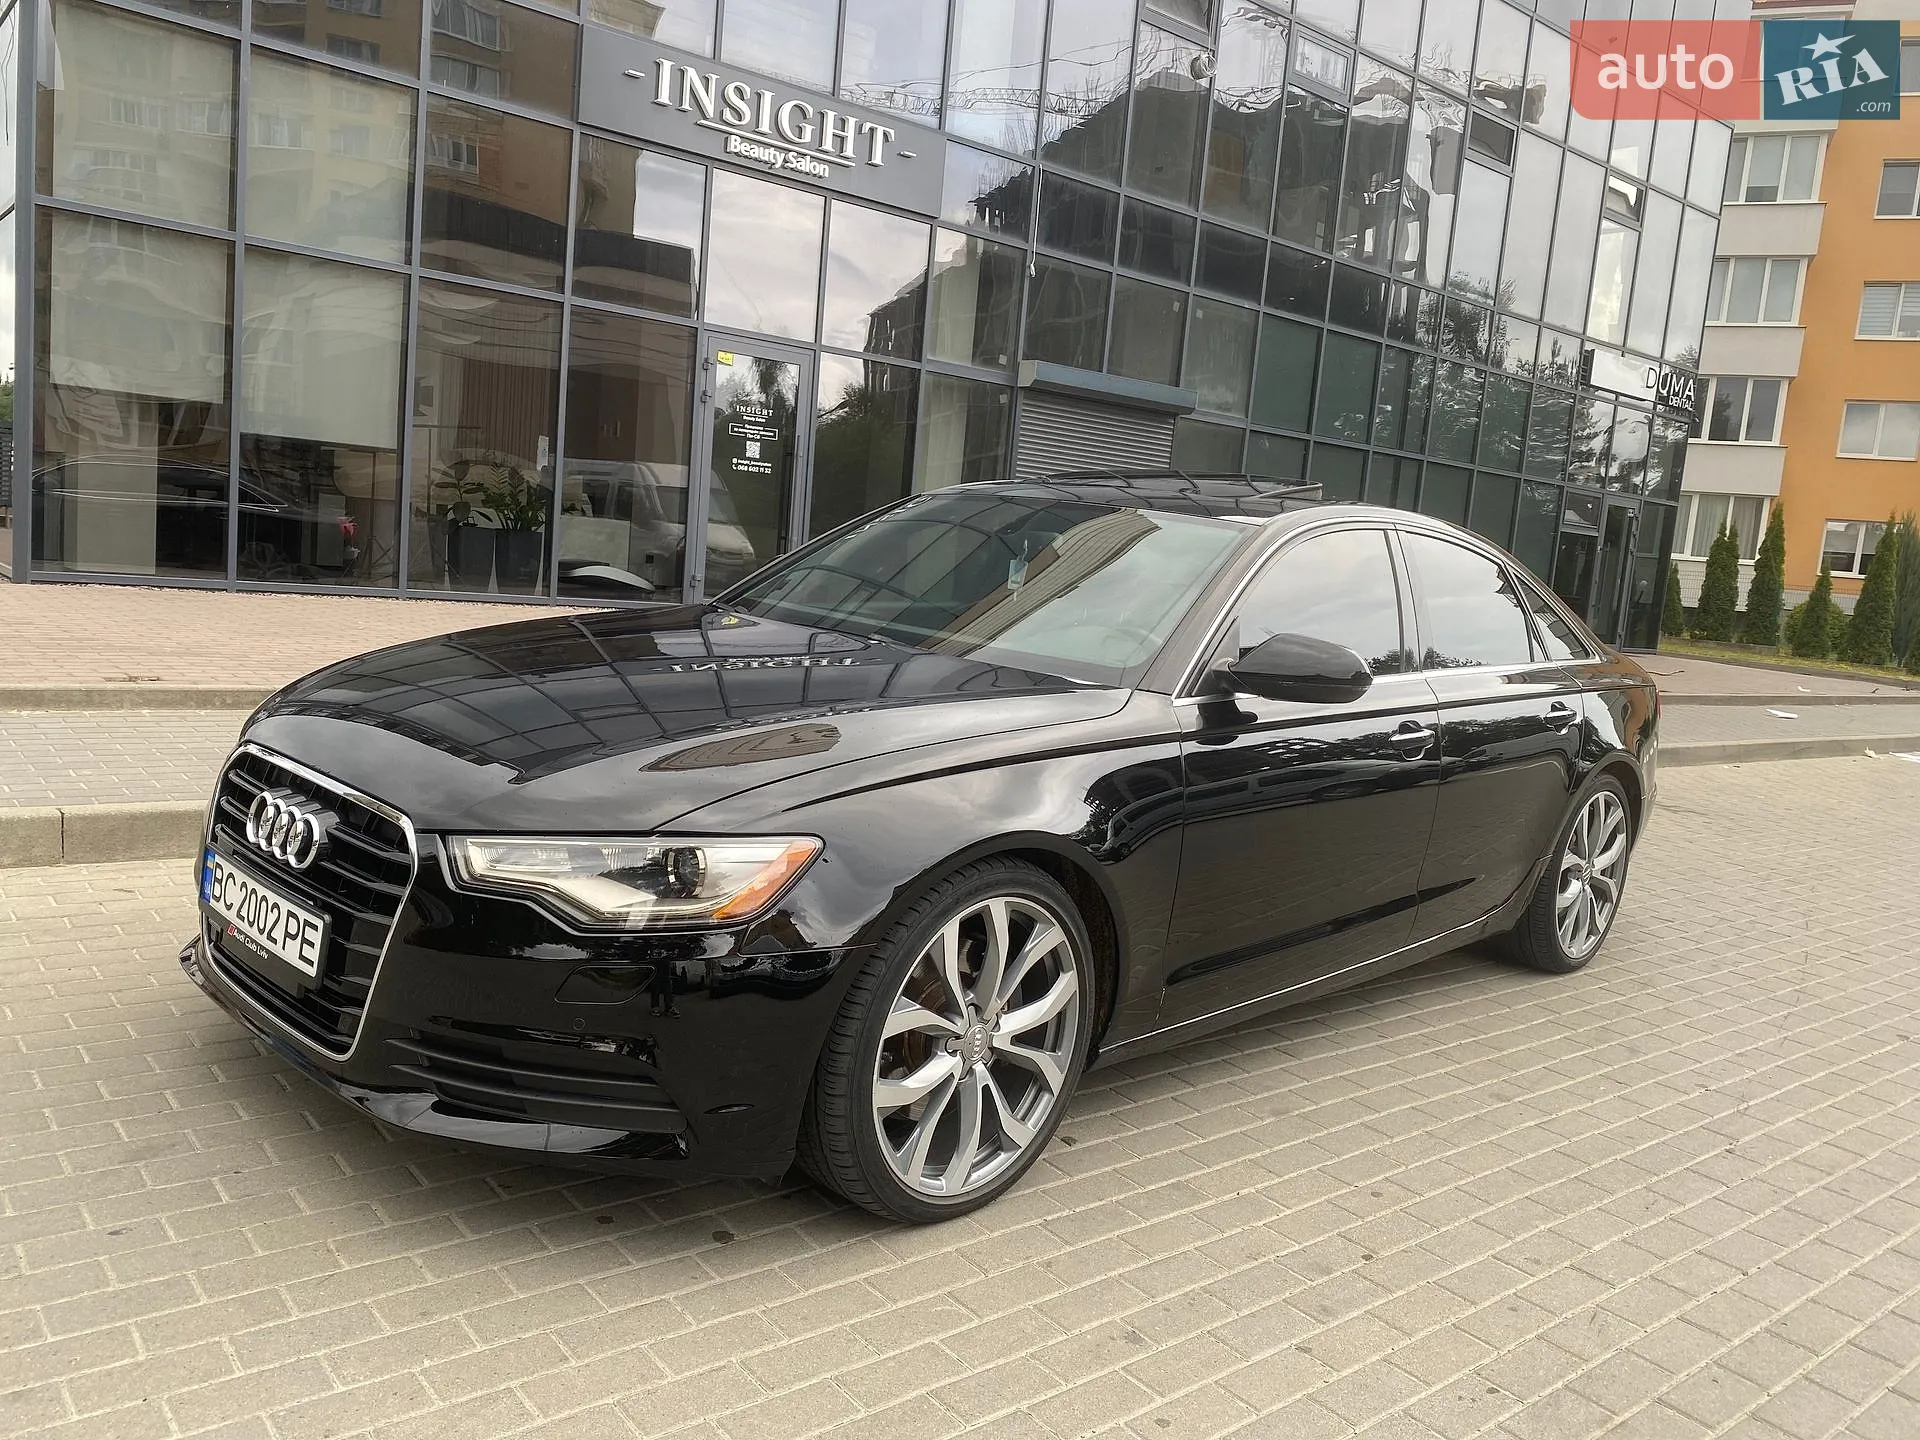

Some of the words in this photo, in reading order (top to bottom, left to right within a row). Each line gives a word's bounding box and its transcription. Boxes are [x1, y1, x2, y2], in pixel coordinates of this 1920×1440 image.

[652, 58, 895, 167] INSIGHT
[727, 135, 786, 168] Beauty
[788, 151, 830, 177] Salon
[1646, 363, 1695, 401] DUMA
[736, 405, 773, 416] INSIGHT
[212, 861, 236, 911] BC
[236, 881, 281, 946] 2002
[282, 909, 319, 968] PE
[233, 929, 245, 943] Audi
[245, 937, 257, 952] Club
